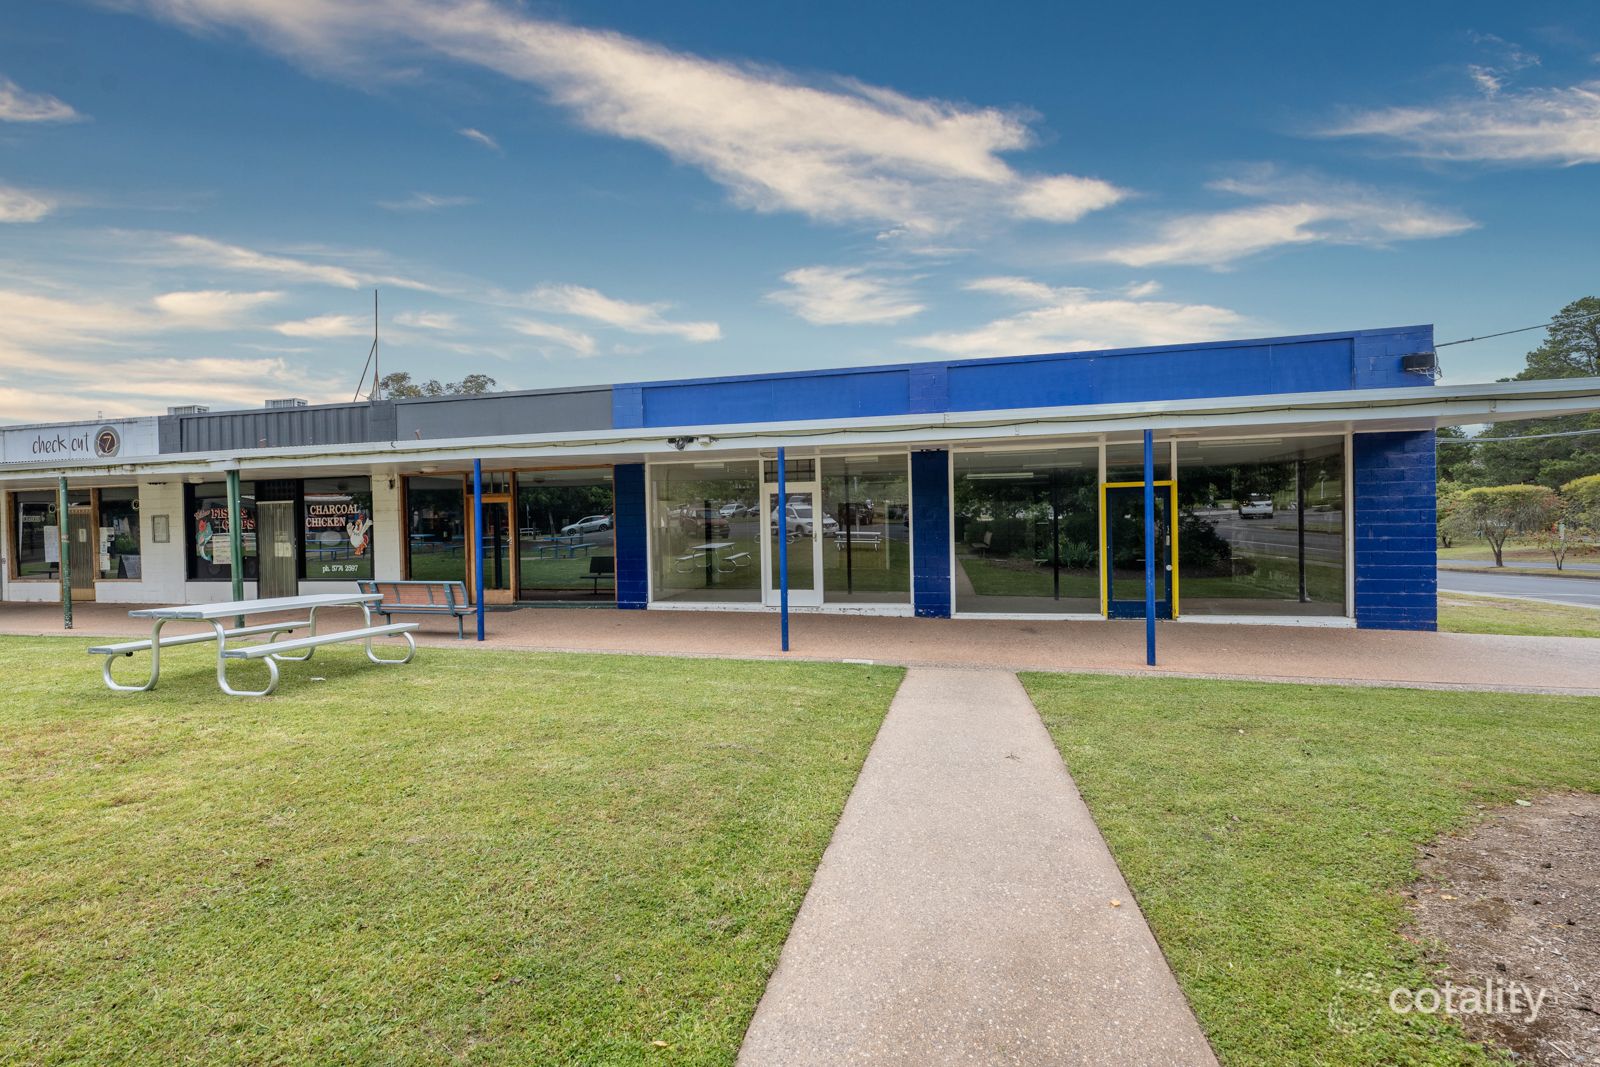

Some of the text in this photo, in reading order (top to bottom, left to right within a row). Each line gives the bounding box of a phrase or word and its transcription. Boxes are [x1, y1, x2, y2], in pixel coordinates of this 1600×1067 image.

[32, 434, 67, 454] check
[71, 432, 89, 452] cut
[211, 508, 232, 519] FIS
[310, 504, 360, 515] CHARCOAL
[221, 519, 256, 531] CPS
[305, 517, 346, 528] CHICKEN
